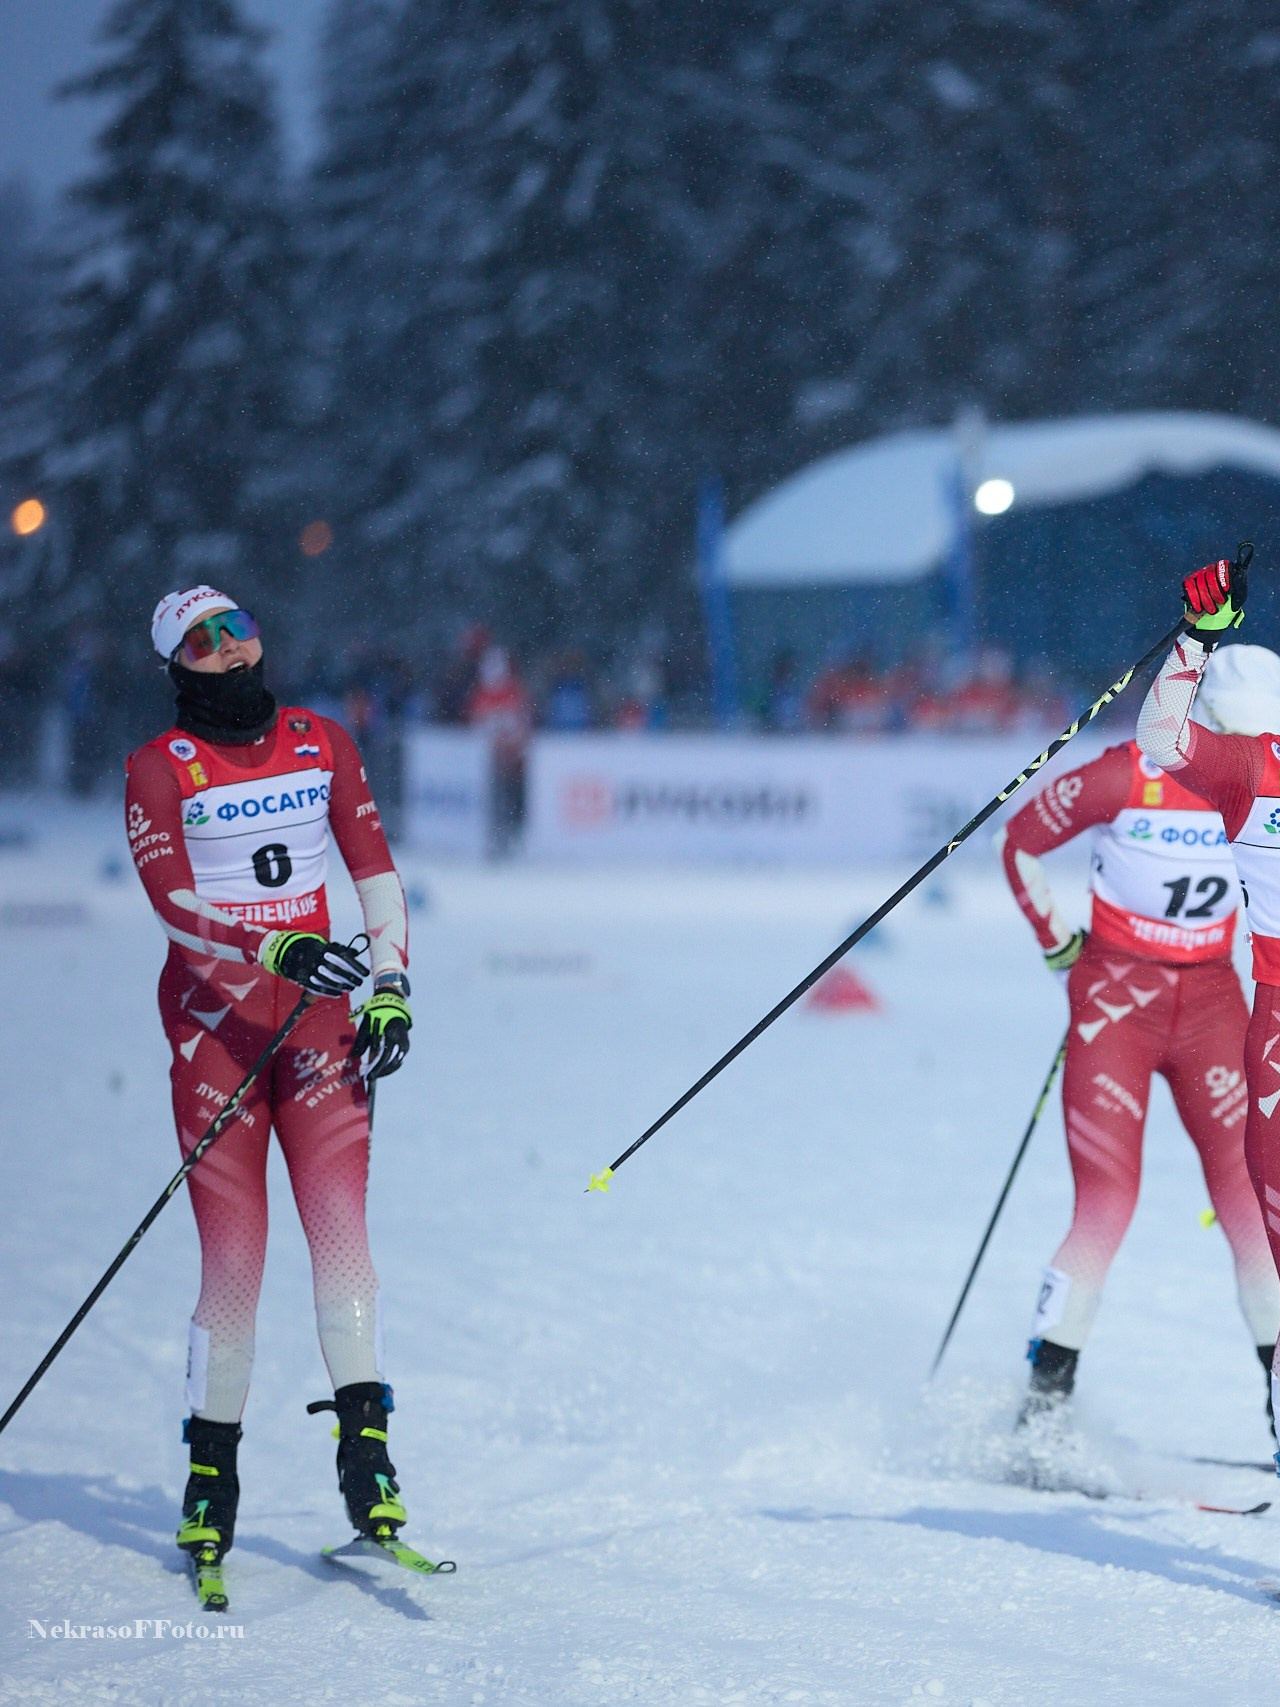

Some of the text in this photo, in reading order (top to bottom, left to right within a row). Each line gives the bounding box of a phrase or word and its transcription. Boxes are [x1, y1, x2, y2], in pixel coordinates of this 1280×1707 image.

[217, 785, 330, 821] ФОСАГРО
[252, 843, 292, 887] 6
[1163, 876, 1228, 917] 12
[294, 1058, 352, 1102] ФОСАГРО
[306, 1073, 359, 1109] BIVIUM
[195, 1082, 256, 1128] ЛУКЙЛ
